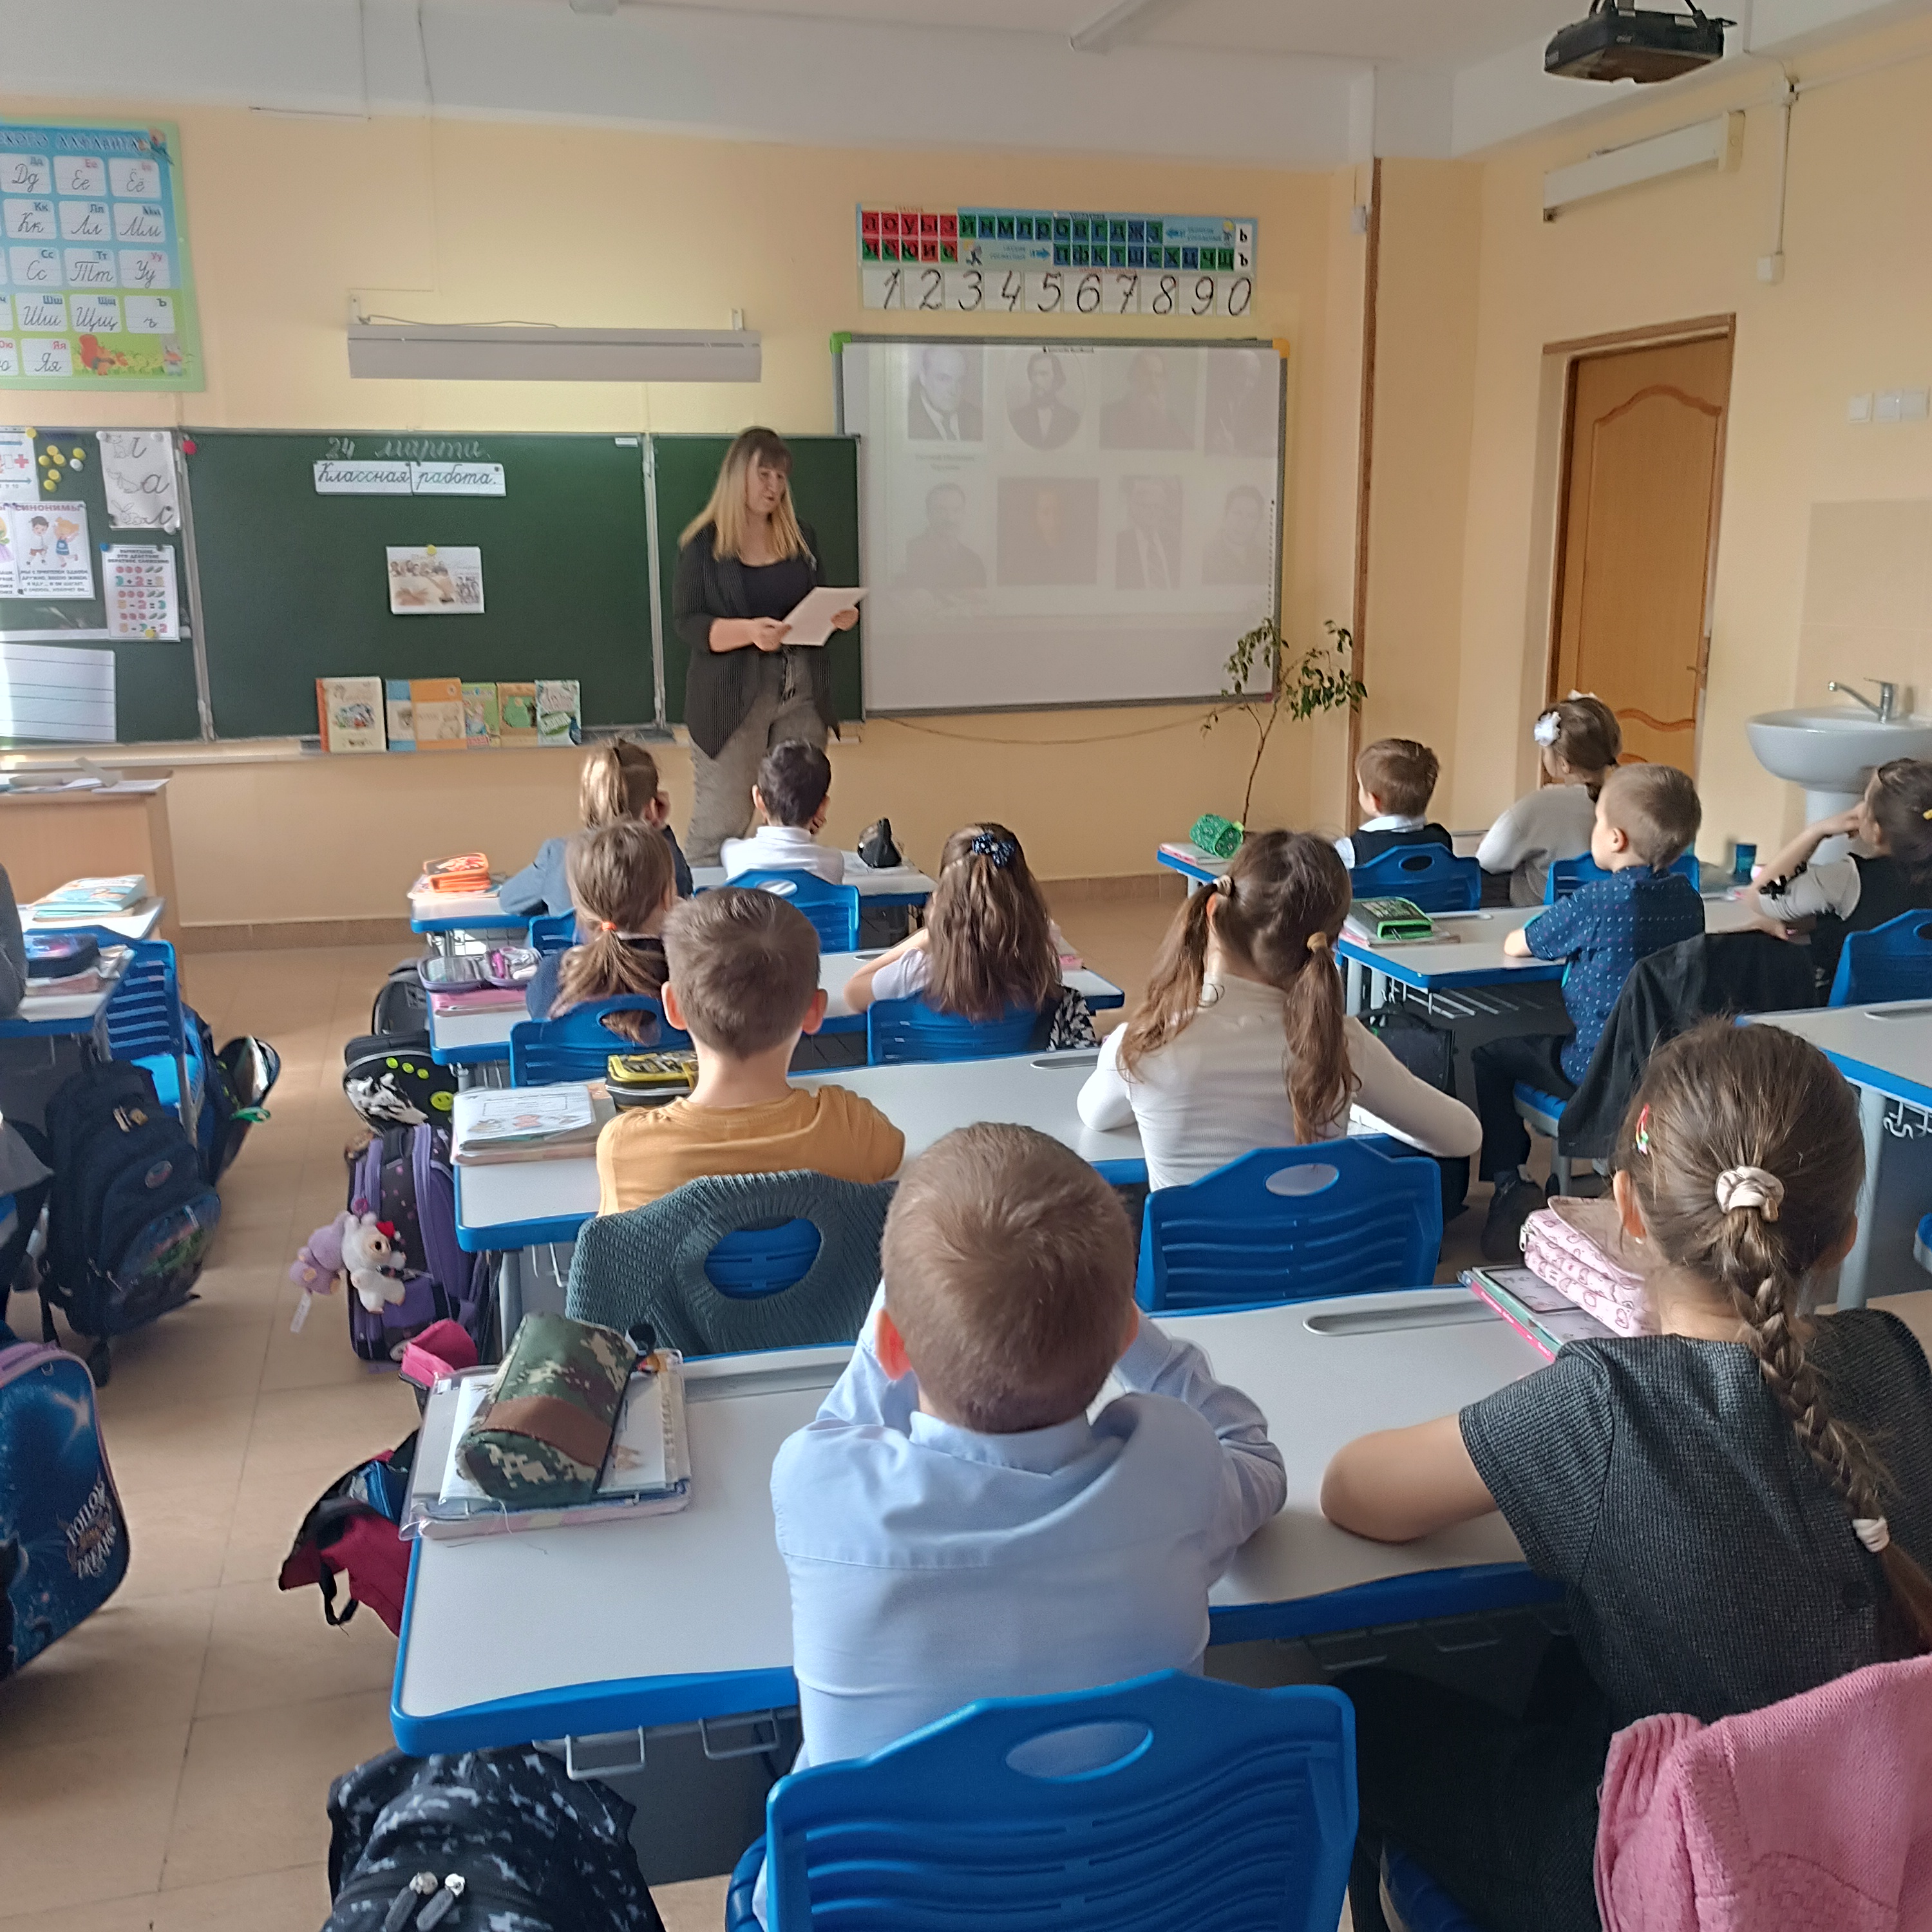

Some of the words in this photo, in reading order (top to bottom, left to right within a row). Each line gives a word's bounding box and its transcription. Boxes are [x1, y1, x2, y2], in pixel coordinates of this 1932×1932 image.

[18, 213, 44, 233] Кк
[885, 269, 900, 310] 1
[920, 269, 942, 310] 2
[959, 271, 982, 310] 3
[1002, 270, 1022, 312] 4
[1038, 272, 1061, 312] 5
[1077, 274, 1100, 312] 6
[1116, 274, 1137, 314] 7
[1153, 275, 1176, 314] 8
[1191, 276, 1213, 315] 9
[1229, 277, 1251, 316] 0
[35, 353, 61, 372] Яя
[318, 463, 410, 483] Классная
[416, 464, 497, 490] работа.
